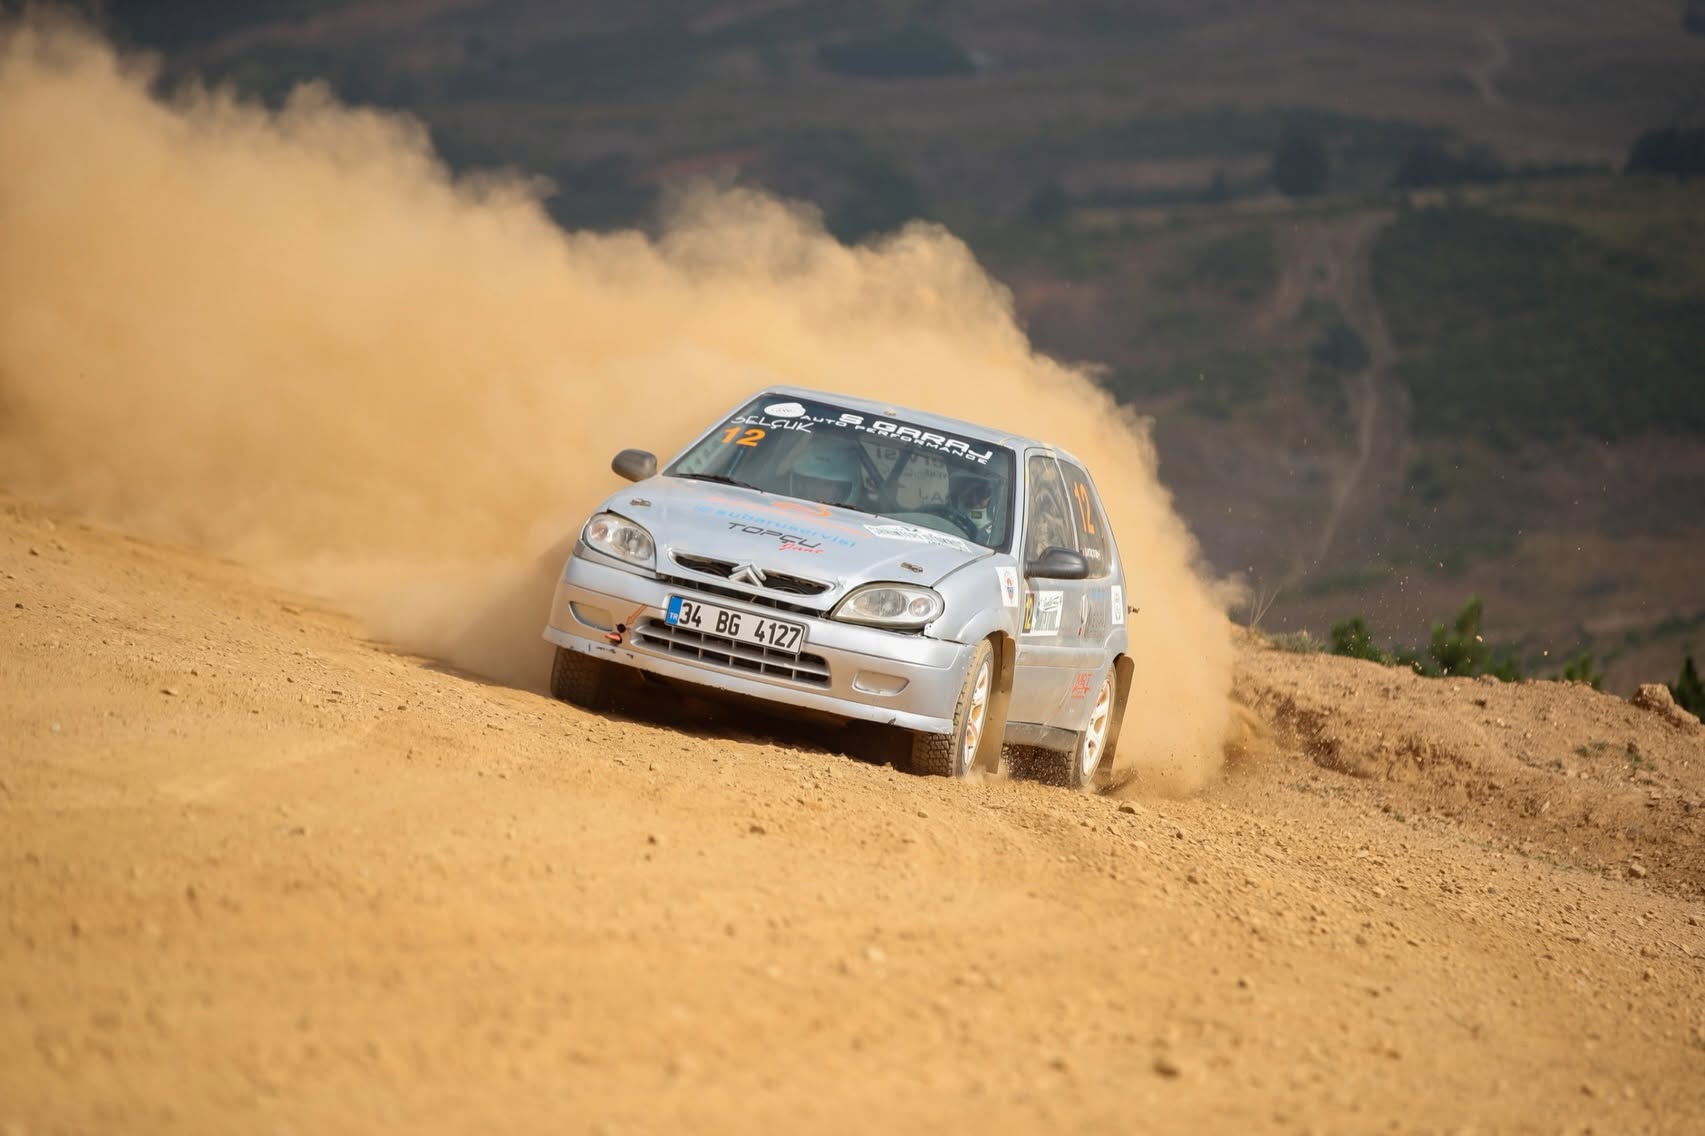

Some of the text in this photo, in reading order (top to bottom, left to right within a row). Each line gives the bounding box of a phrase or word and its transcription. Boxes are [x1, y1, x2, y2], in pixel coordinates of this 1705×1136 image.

[722, 426, 766, 447] 12
[800, 415, 848, 428] AUTO
[854, 425, 988, 465] PERFORMANCE
[838, 413, 864, 426] S
[872, 420, 993, 460] GARAJ
[1073, 481, 1095, 534] 12
[728, 521, 822, 549] TOPÇU
[669, 612, 679, 621] TR
[679, 602, 801, 649] 34 BG 4127
